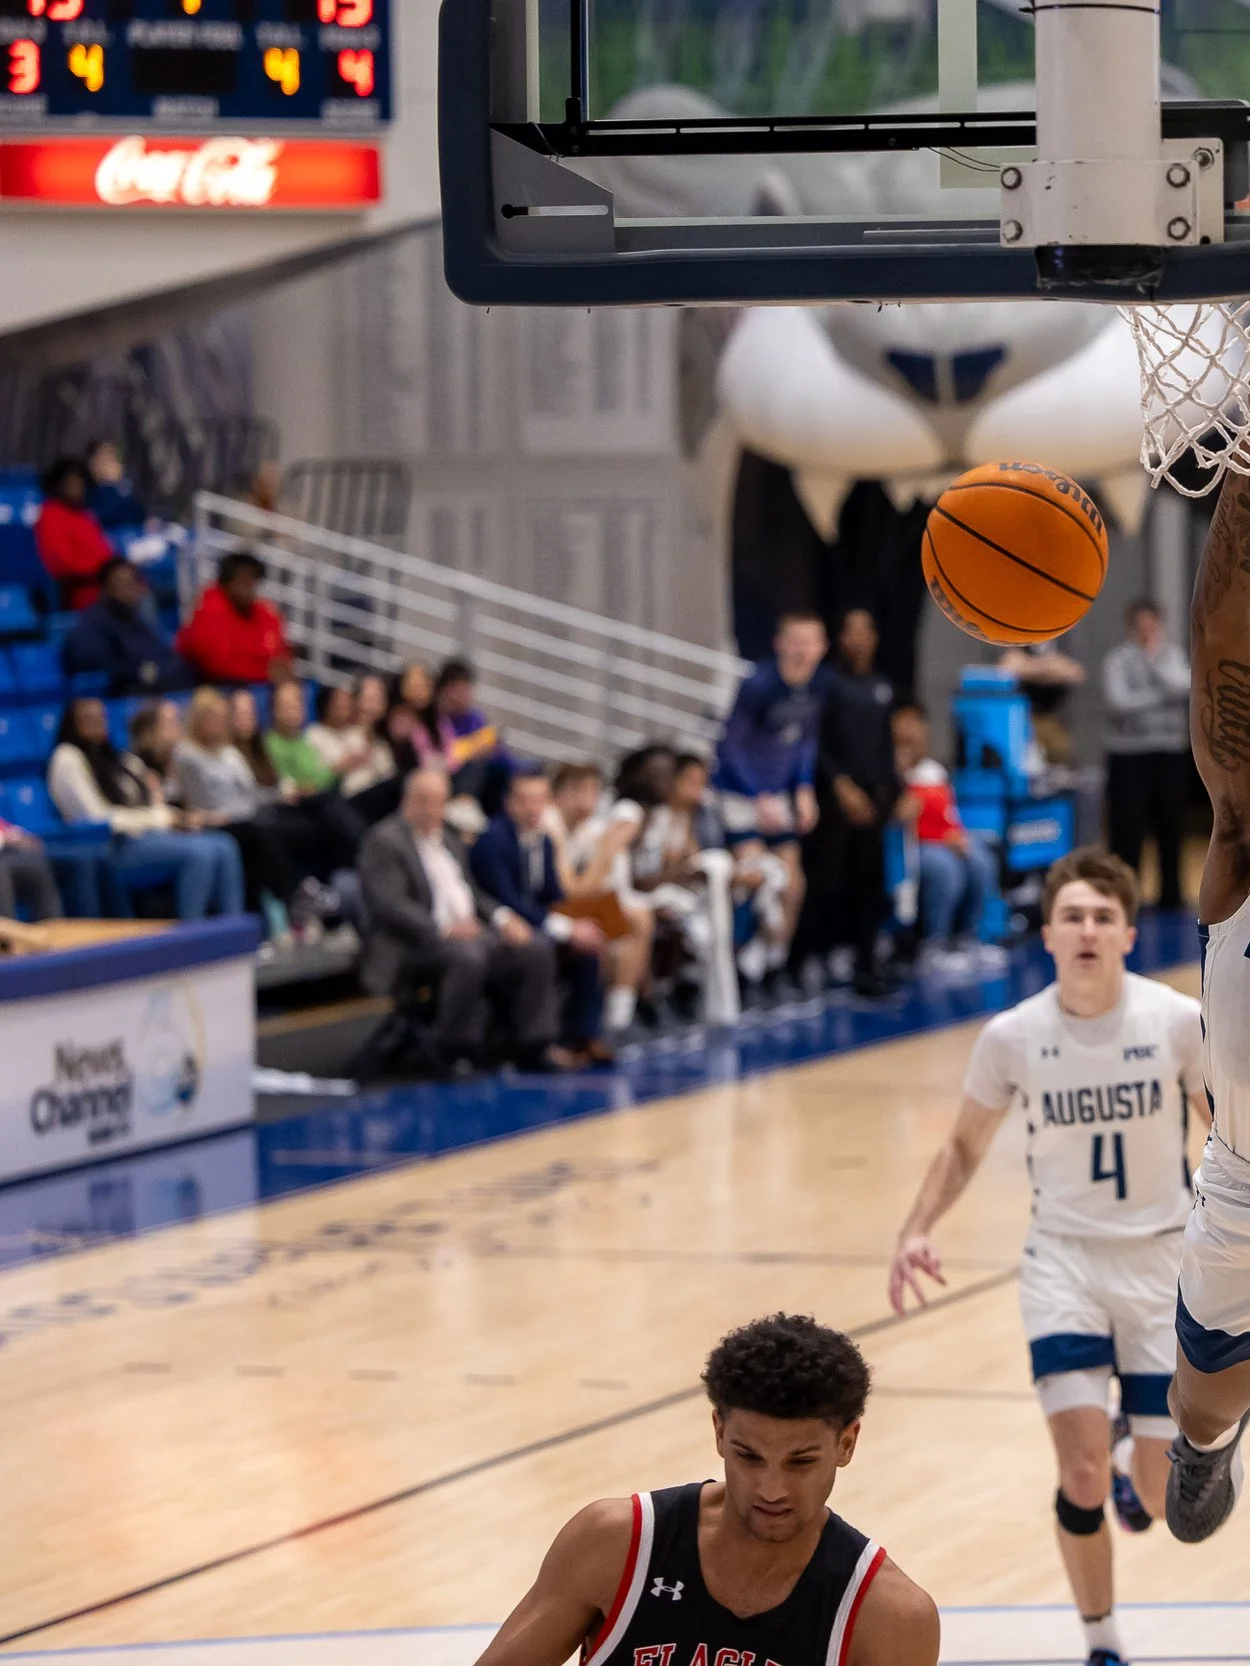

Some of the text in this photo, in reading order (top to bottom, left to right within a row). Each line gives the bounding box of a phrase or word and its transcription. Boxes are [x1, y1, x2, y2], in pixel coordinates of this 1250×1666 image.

[8, 39, 41, 94] 3
[67, 43, 104, 92] 4
[263, 47, 300, 96] 4
[337, 48, 374, 97] 4
[1042, 1079, 1162, 1127] AUGUSTA
[1090, 1132, 1128, 1200] 4
